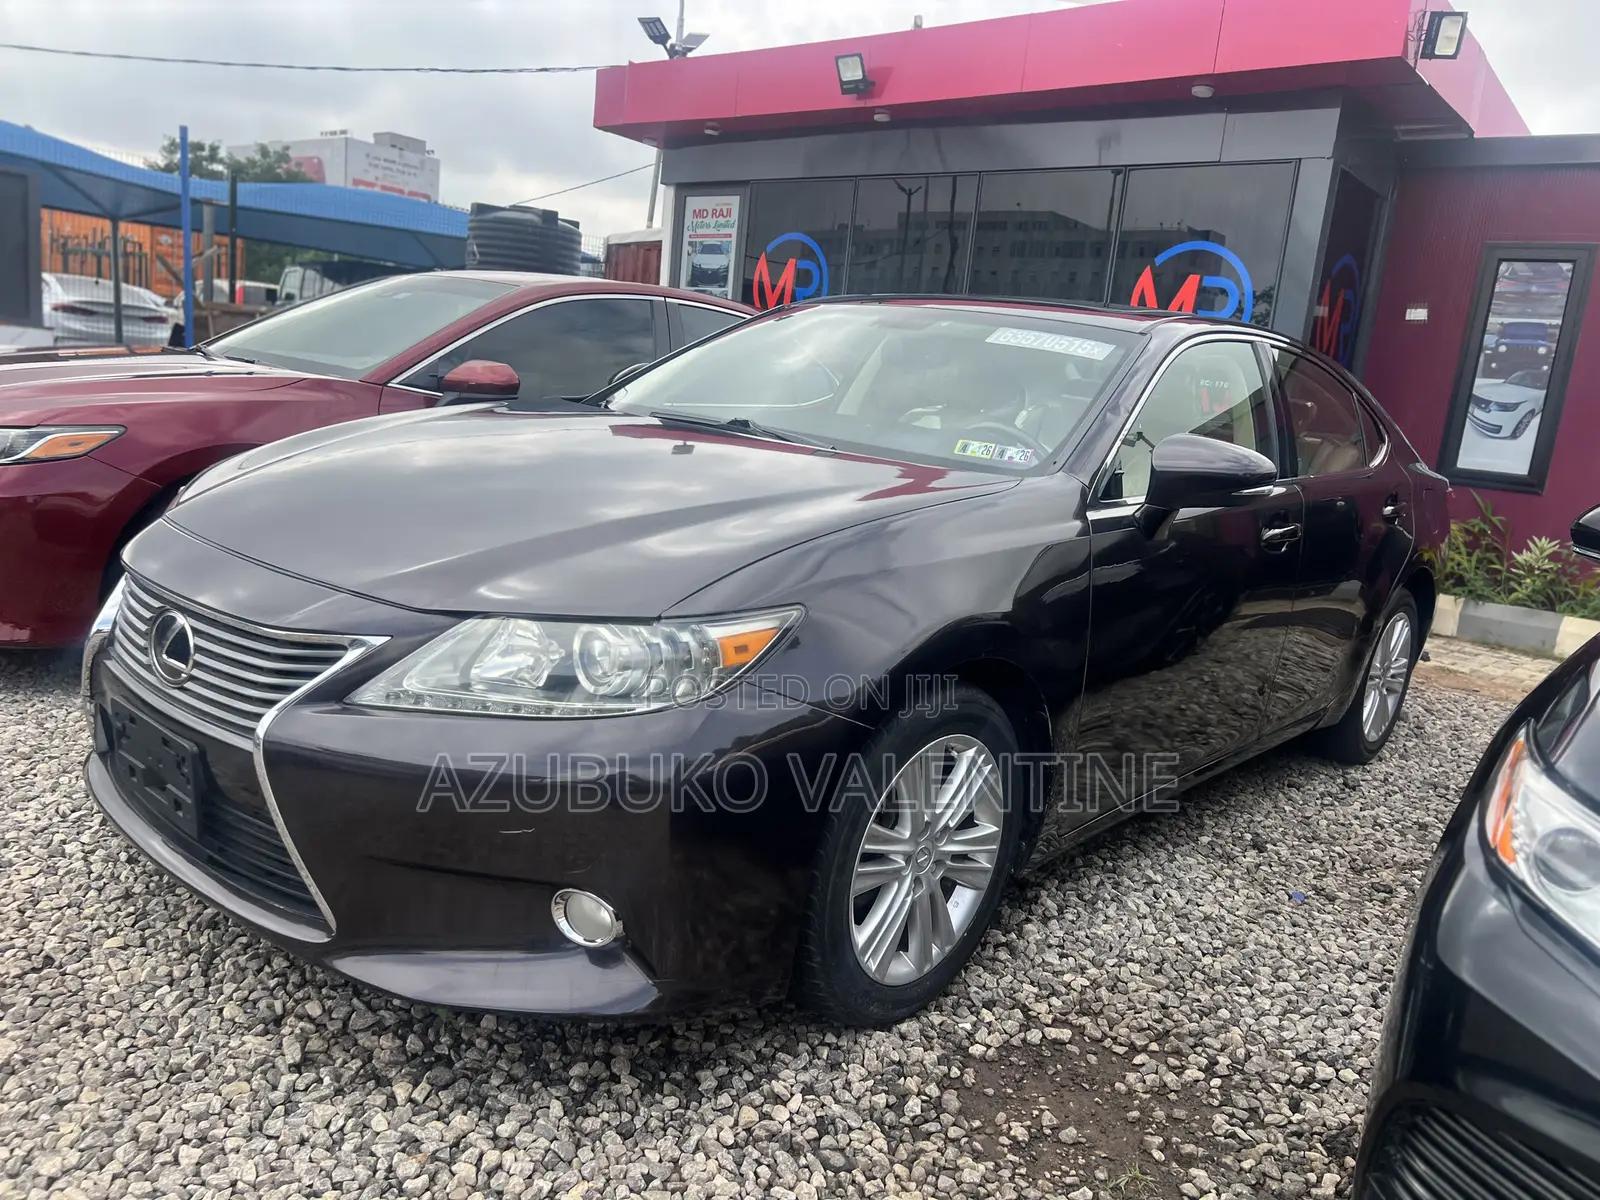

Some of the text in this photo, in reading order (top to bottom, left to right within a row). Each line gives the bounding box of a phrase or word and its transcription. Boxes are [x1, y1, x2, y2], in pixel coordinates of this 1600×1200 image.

[692, 207, 732, 219] MD RAJI
[713, 219, 736, 232] Limited
[981, 444, 993, 456] 26
[1019, 449, 1031, 461] 26
